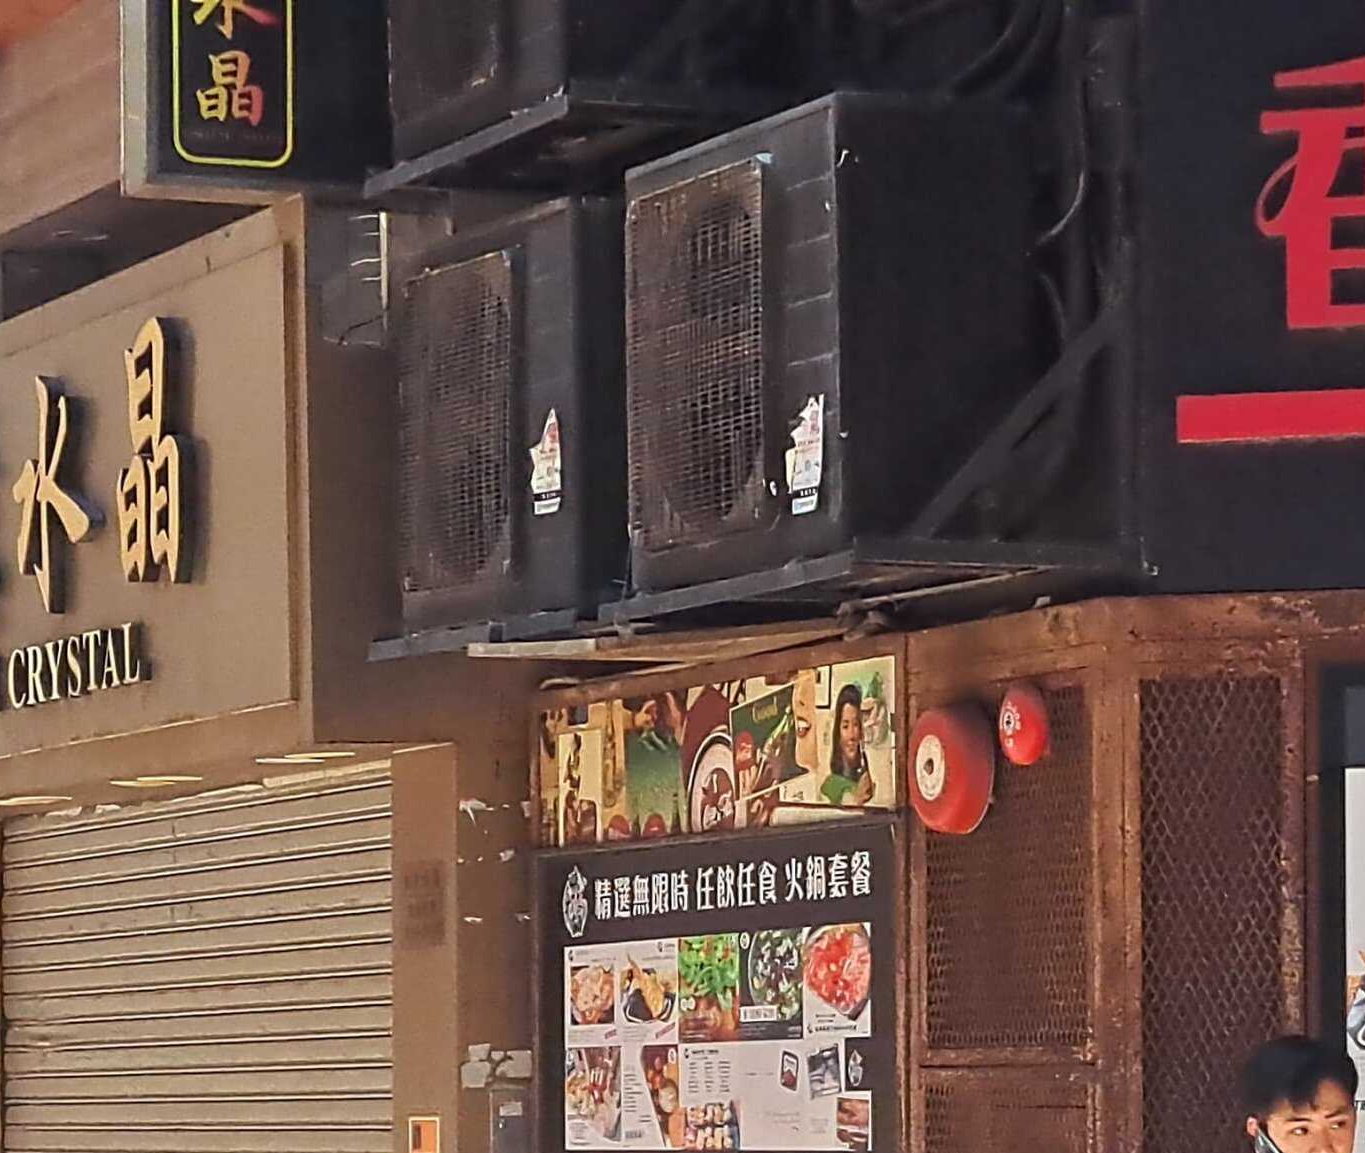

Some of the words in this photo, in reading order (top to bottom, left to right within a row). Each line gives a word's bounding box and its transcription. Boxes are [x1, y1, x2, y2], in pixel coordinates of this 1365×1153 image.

[7, 622, 143, 710] CRYSTAL
[594, 869, 689, 921] 精選無限時
[695, 861, 778, 912] 任飲任食
[784, 850, 872, 901] 火鍋套餐
